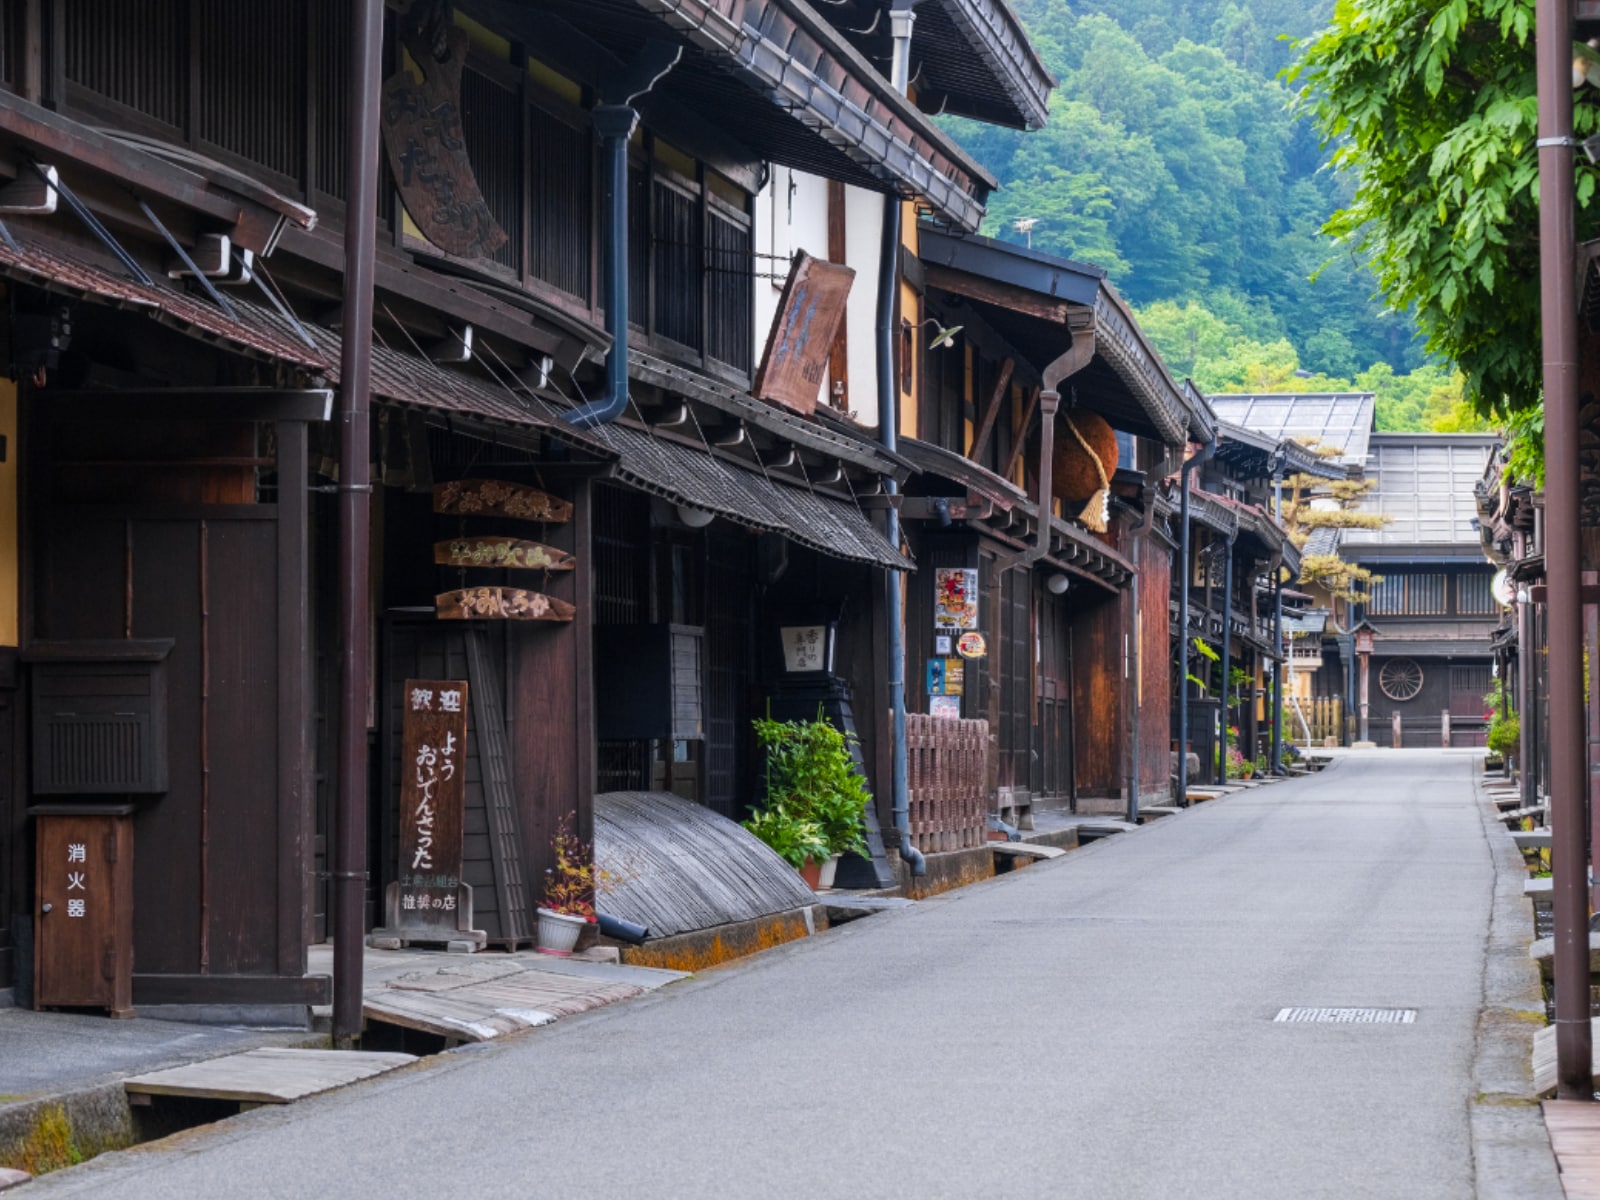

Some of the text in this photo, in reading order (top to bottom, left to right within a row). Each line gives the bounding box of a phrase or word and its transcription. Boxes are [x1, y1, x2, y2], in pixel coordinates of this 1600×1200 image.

[794, 631, 806, 667] 専門店
[806, 629, 819, 661] 香りの
[410, 687, 461, 713] 歓迎
[440, 730, 457, 782] よう
[66, 843, 87, 917] 消火器
